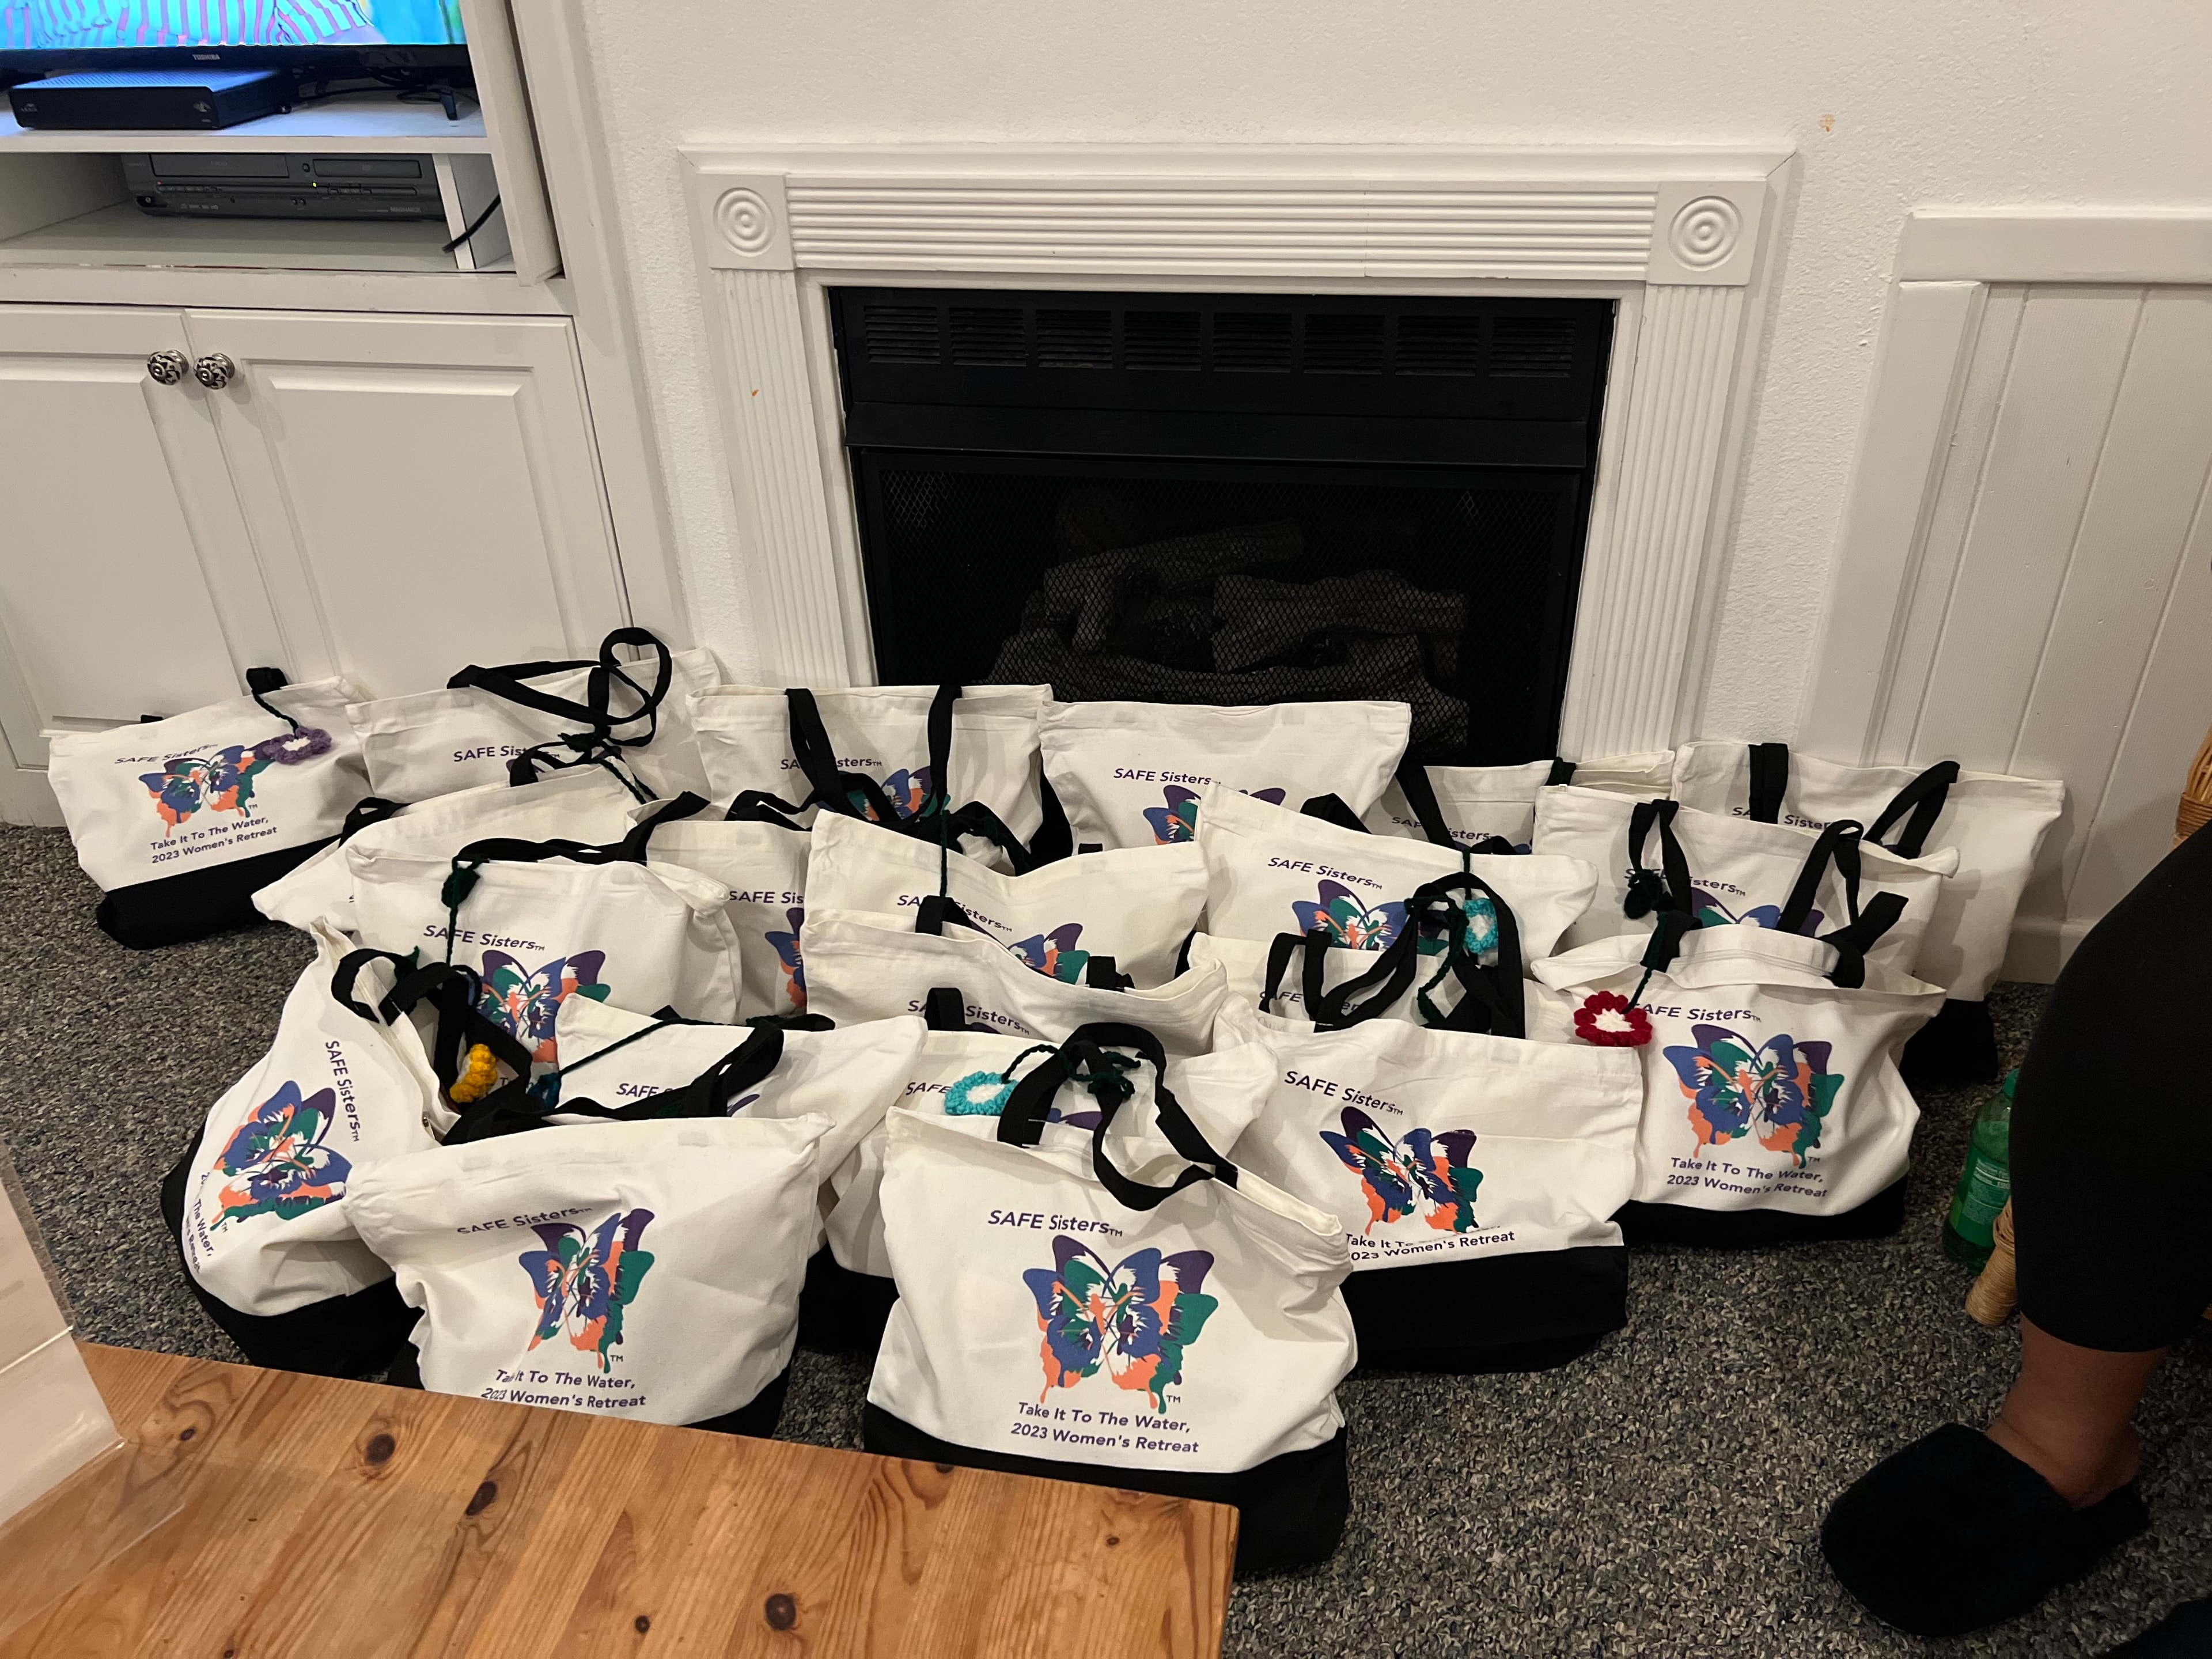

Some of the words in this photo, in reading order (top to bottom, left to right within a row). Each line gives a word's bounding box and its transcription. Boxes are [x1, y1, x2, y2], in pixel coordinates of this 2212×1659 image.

[115, 756, 160, 764] SAFE
[453, 747, 495, 762] SAFE
[1113, 768, 1156, 781] SAFE
[150, 839, 177, 850] Take
[180, 835, 188, 843] It
[191, 832, 204, 840] To
[209, 826, 228, 836] The
[232, 817, 268, 830] Water,
[152, 850, 180, 863] 2023
[183, 838, 233, 855] Women's
[237, 826, 277, 842] Retreat
[1267, 857, 1314, 872] SAFE
[729, 891, 775, 903] SAFE
[325, 1040, 349, 1076] SAFE
[906, 1082, 952, 1095] SAFE
[1285, 1071, 1339, 1097] SAFE
[1671, 1157, 1703, 1171] Take
[1706, 1161, 1717, 1172] It
[1722, 1162, 1740, 1175] To
[1746, 1166, 1773, 1180] The
[1779, 1171, 1823, 1183] Water,
[1667, 1175, 1699, 1185] 2023
[1705, 1177, 1771, 1194] Women's
[1774, 1183, 1827, 1197] Retreat
[194, 1198, 202, 1220] The
[988, 1210, 1044, 1229] SAFE
[457, 1219, 510, 1234] SAFE
[197, 1218, 214, 1257] Water,
[1346, 1233, 1376, 1248] Take
[1381, 1239, 1391, 1248] It
[1350, 1252, 1379, 1260] 023
[1384, 1241, 1455, 1256] Women's
[1460, 1231, 1515, 1247] Retreat
[529, 1370, 548, 1383] To
[555, 1372, 582, 1385] The
[588, 1374, 635, 1389] Water,
[480, 1387, 507, 1400] 2023
[510, 1389, 583, 1406] Women's
[588, 1395, 646, 1408] Retreat
[1018, 1402, 1050, 1418] Take
[1054, 1408, 1066, 1421] It
[1072, 1410, 1092, 1423] To
[1099, 1411, 1128, 1426] The
[1135, 1415, 1190, 1433] Water,
[1011, 1422, 1048, 1439] 2023
[1053, 1429, 1130, 1448] Women's
[1135, 1436, 1199, 1452] Retreat
